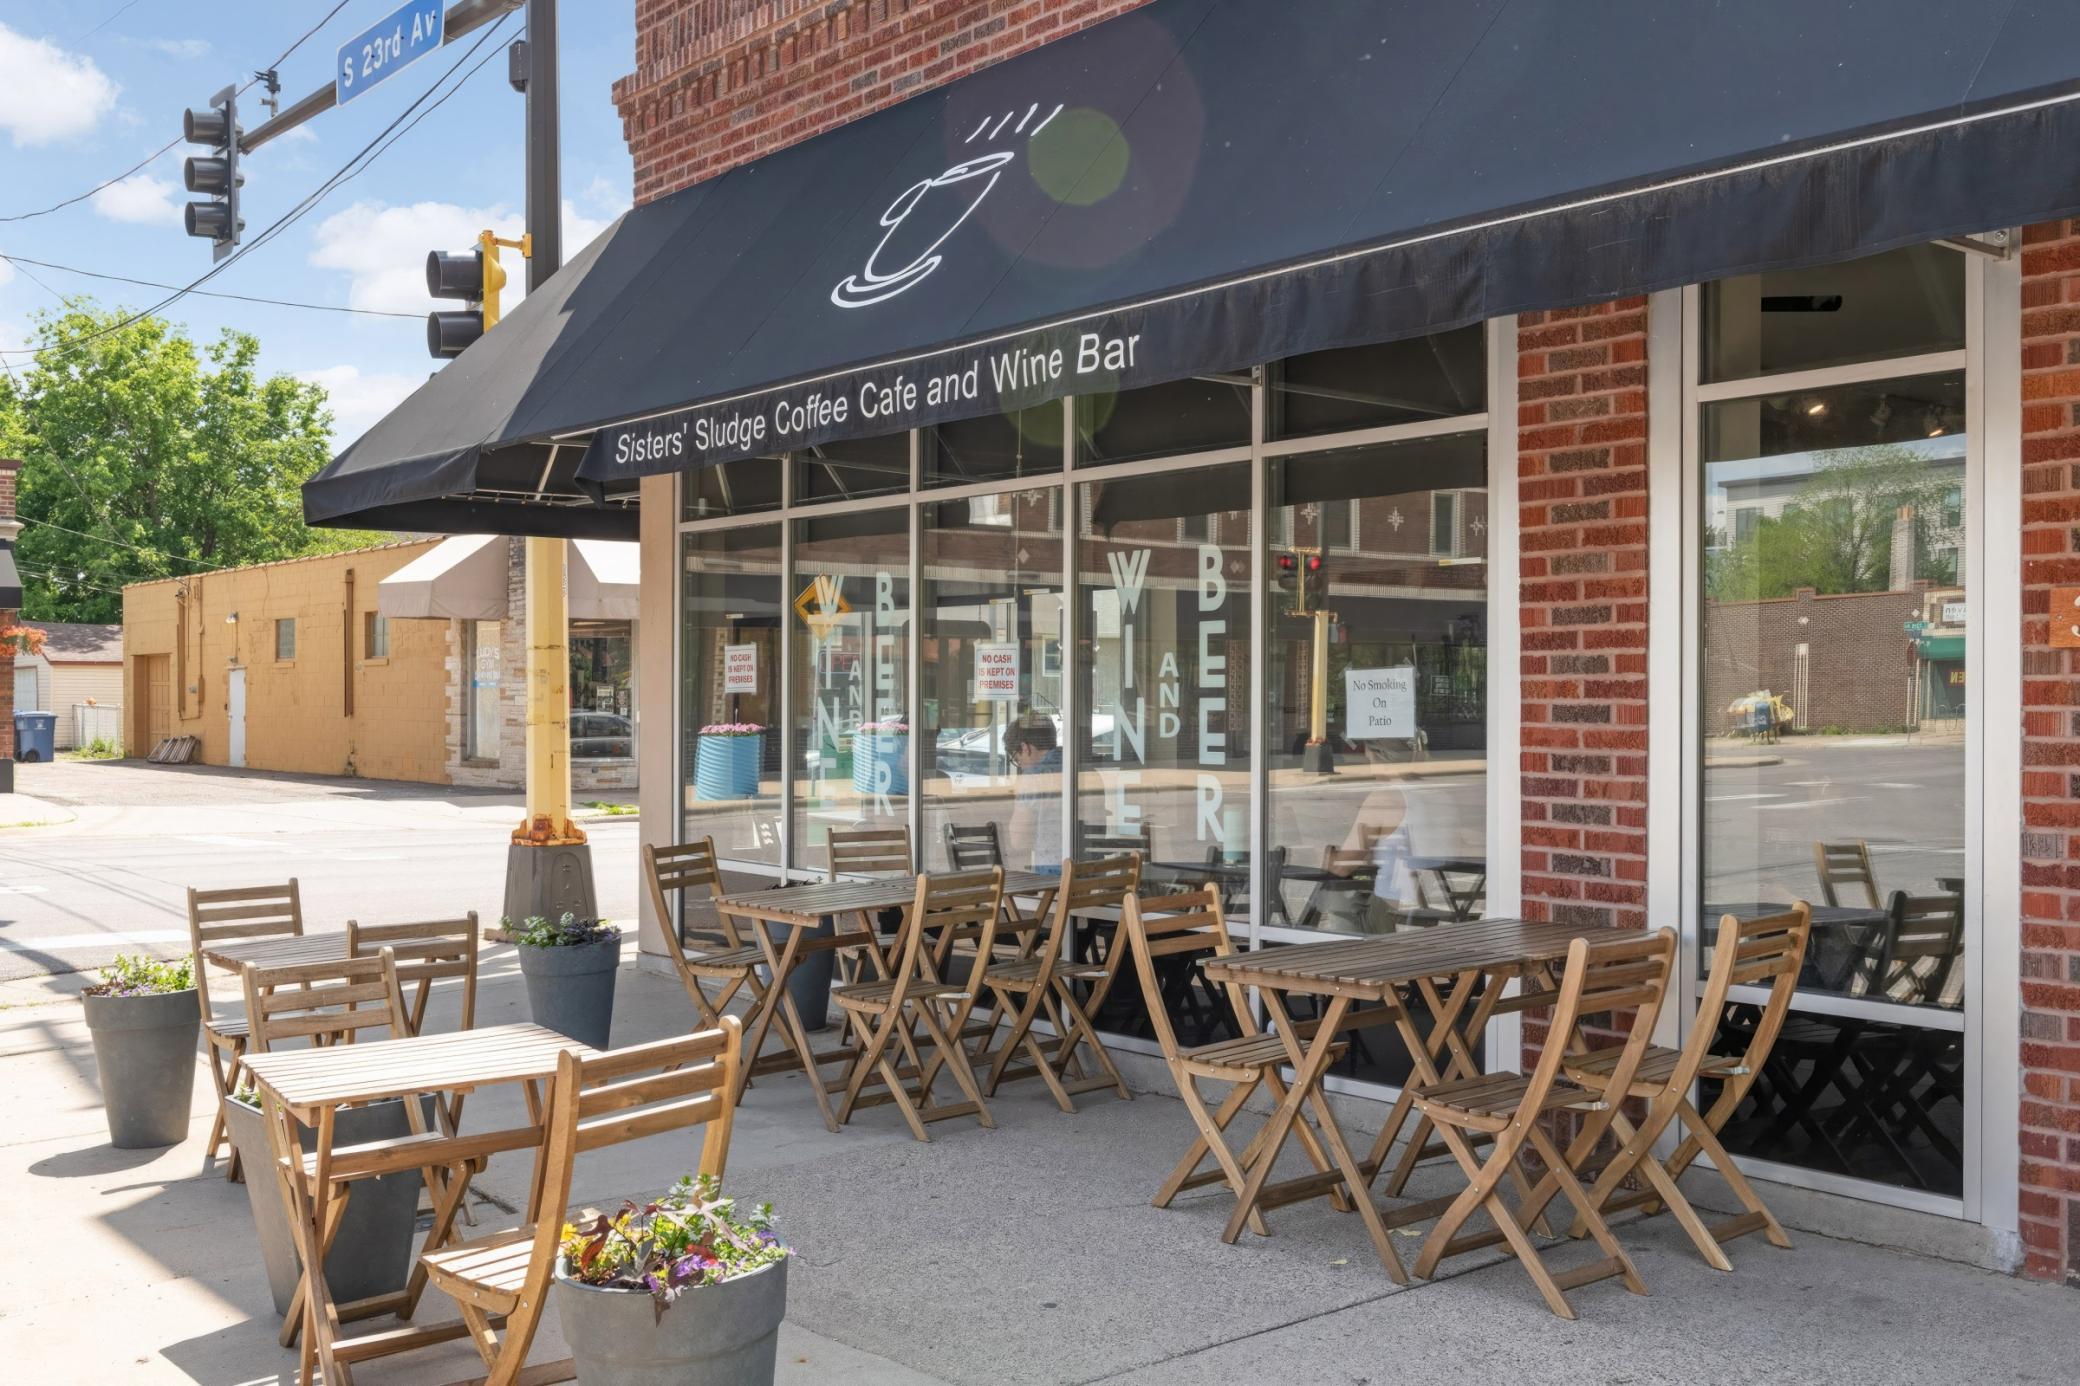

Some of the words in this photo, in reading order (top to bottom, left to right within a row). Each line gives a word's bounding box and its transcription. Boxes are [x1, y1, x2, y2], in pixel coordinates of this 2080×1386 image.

[344, 57, 353, 87] S
[362, 24, 400, 77] 23rd
[411, 10, 435, 47] Av
[616, 422, 687, 464] Sisters'
[695, 412, 765, 450] Sludge
[775, 393, 848, 435] Coffee
[860, 375, 917, 419] Cafe
[927, 360, 978, 406] and
[990, 348, 1063, 394] Wine
[1077, 333, 1141, 375] Bar
[731, 654, 737, 662] NO
[738, 653, 752, 661] CASH
[734, 664, 746, 673] KEPT
[978, 667, 985, 676] IS
[987, 667, 1005, 676] KEPT
[1006, 667, 1016, 676] ON
[982, 654, 991, 663] NO
[993, 654, 1012, 664] CASH
[815, 575, 844, 812] WINE
[848, 660, 863, 732] AND
[874, 571, 895, 816] BEER
[980, 680, 1014, 690] PREMISES
[1107, 549, 1151, 836] WINE
[1159, 652, 1180, 738] AND
[1198, 544, 1226, 842] BEER
[1353, 680, 1366, 691] No
[1367, 678, 1407, 692] Smoking
[1372, 697, 1387, 708] On
[1369, 715, 1392, 727] Patio
